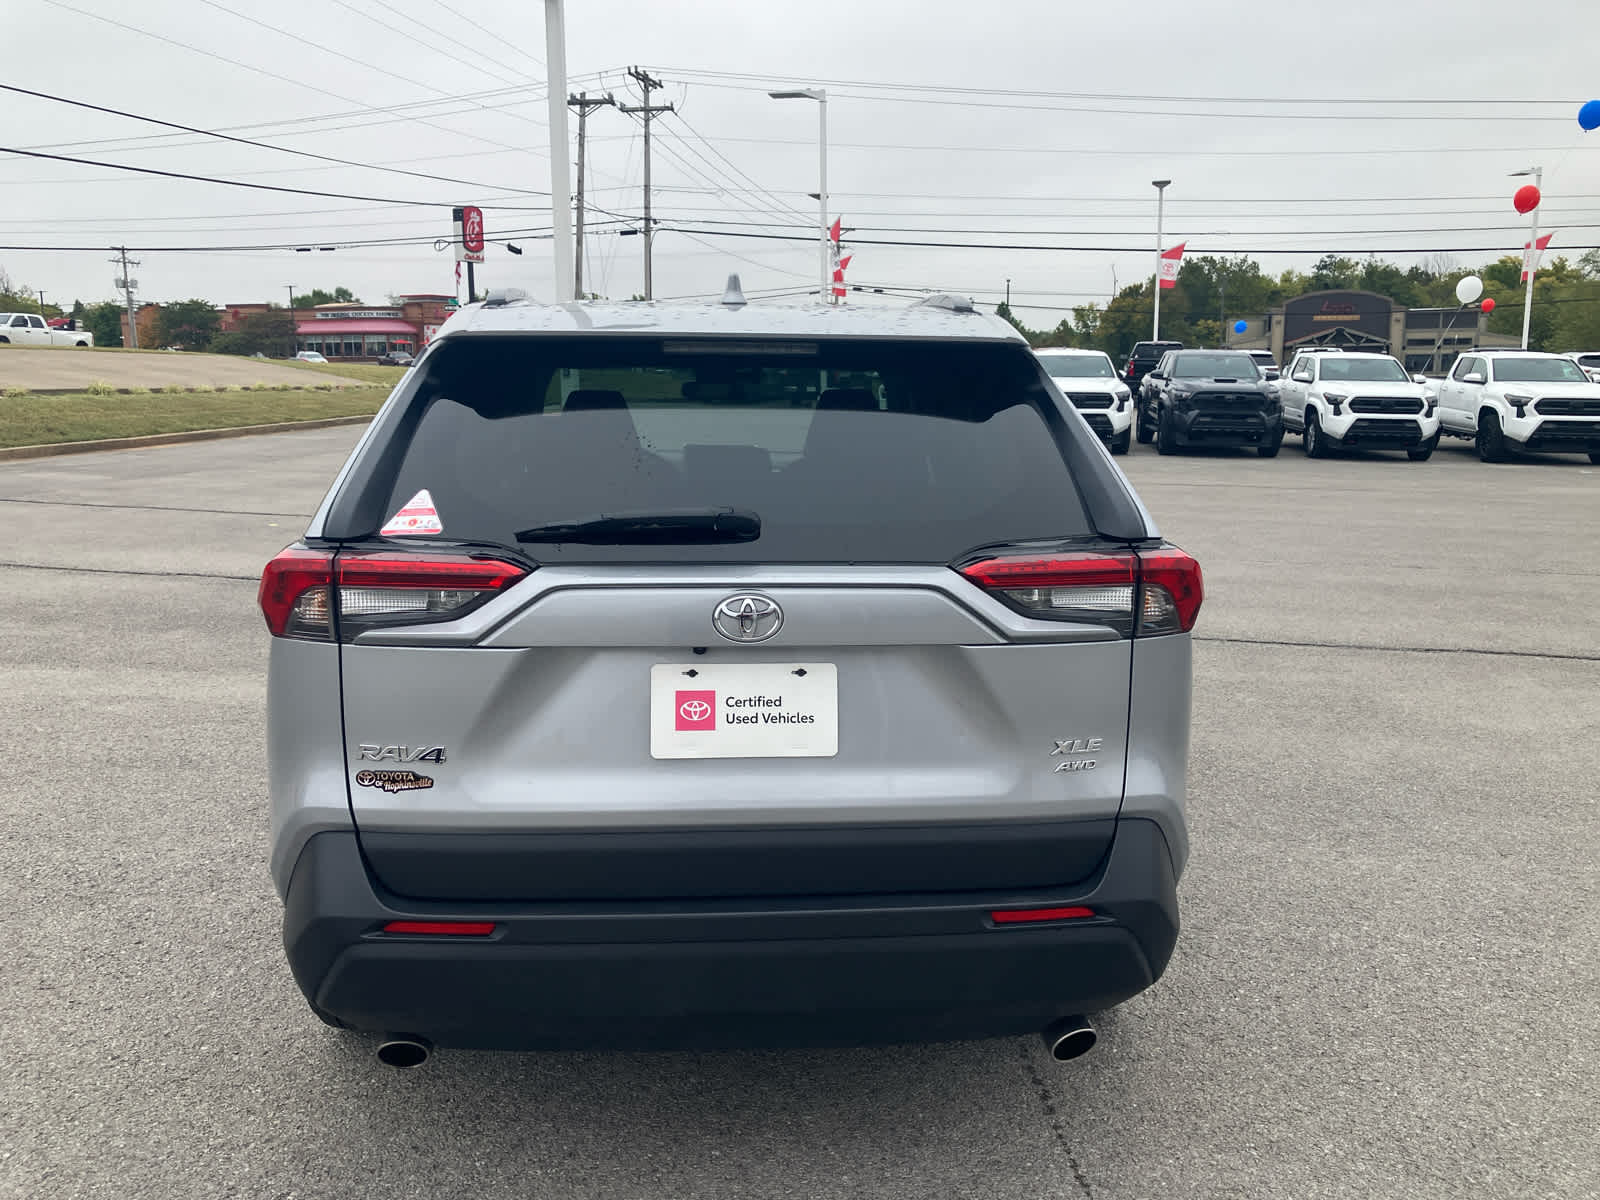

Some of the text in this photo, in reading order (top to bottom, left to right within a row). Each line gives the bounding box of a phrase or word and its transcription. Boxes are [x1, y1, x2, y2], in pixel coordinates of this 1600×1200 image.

[725, 695, 782, 708] Certified
[725, 712, 815, 725] Used Vehicles
[1050, 738, 1103, 756] XLE
[358, 744, 447, 764] RAV4
[1053, 759, 1097, 773] AWD
[375, 771, 414, 781] TOYOTA
